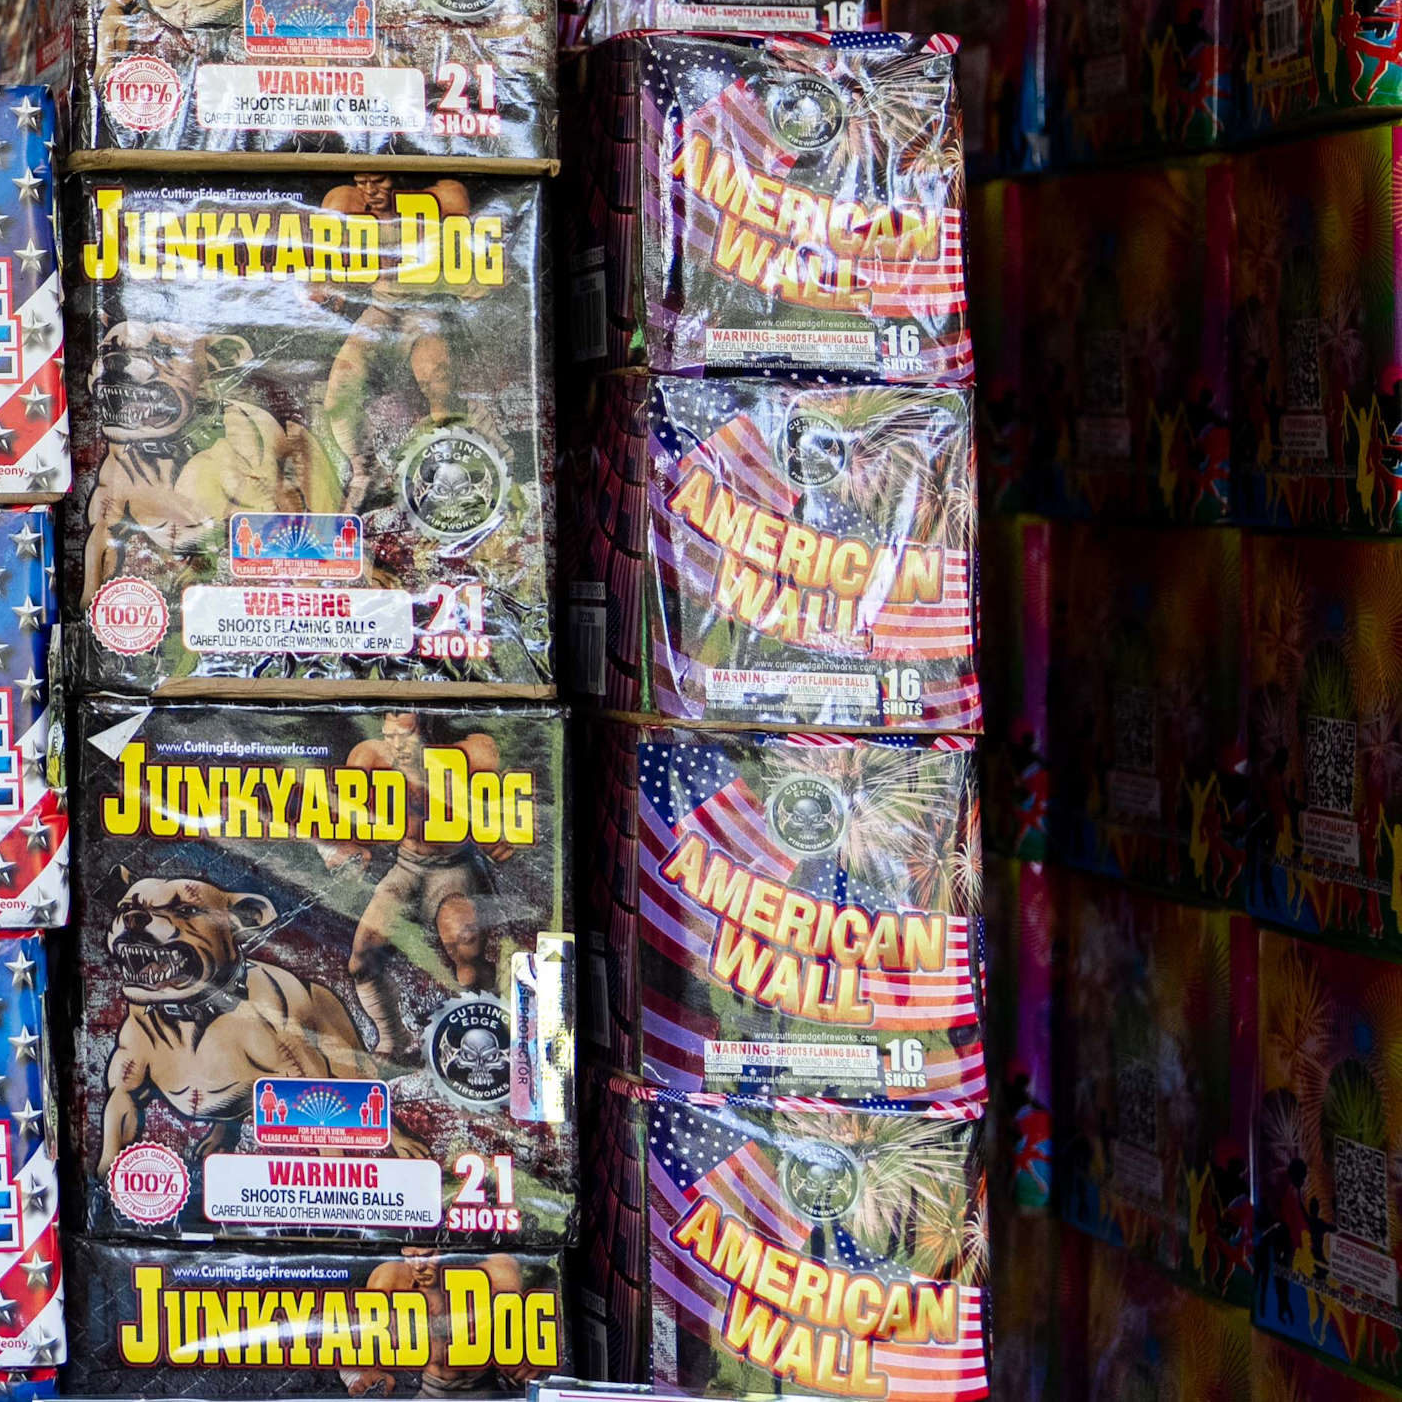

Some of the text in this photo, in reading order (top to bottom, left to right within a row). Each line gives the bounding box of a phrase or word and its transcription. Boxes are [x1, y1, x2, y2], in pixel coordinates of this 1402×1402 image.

[438, 62, 494, 110] 21
[672, 137, 939, 260] AMERICAN
[83, 189, 504, 286] JUNKYARD DOG
[715, 215, 871, 310] WALL
[884, 325, 920, 356] 16
[669, 470, 941, 603] AMERICAN
[716, 556, 871, 652] WALL
[885, 669, 920, 700] 16
[883, 702, 922, 716] SHOTS
[156, 741, 328, 756] www.CuttingEdgeFireworks.com
[103, 741, 534, 844] JUNKYARD DOG
[661, 837, 947, 972] AMERICAN
[711, 921, 873, 1023] WALL
[754, 1031, 877, 1042] www.cuttingedgefireworks.com
[886, 1039, 922, 1071] 16
[885, 1074, 926, 1087] SHOTS
[241, 1189, 404, 1206] SHOOTS FLAMING BALLS
[269, 1162, 378, 1188] WARNING
[455, 1155, 512, 1203] 21
[212, 1205, 433, 1222] CAREFULLY READ OTHER WARNING ON SIDE PANEL
[448, 1208, 519, 1230] SHOTS
[173, 1265, 348, 1280] www.CuttingEdgeFireworks.com
[674, 1201, 958, 1342] AMERICAN
[121, 1266, 558, 1367] JUNKYARD DOG
[726, 1290, 887, 1397] WALL
